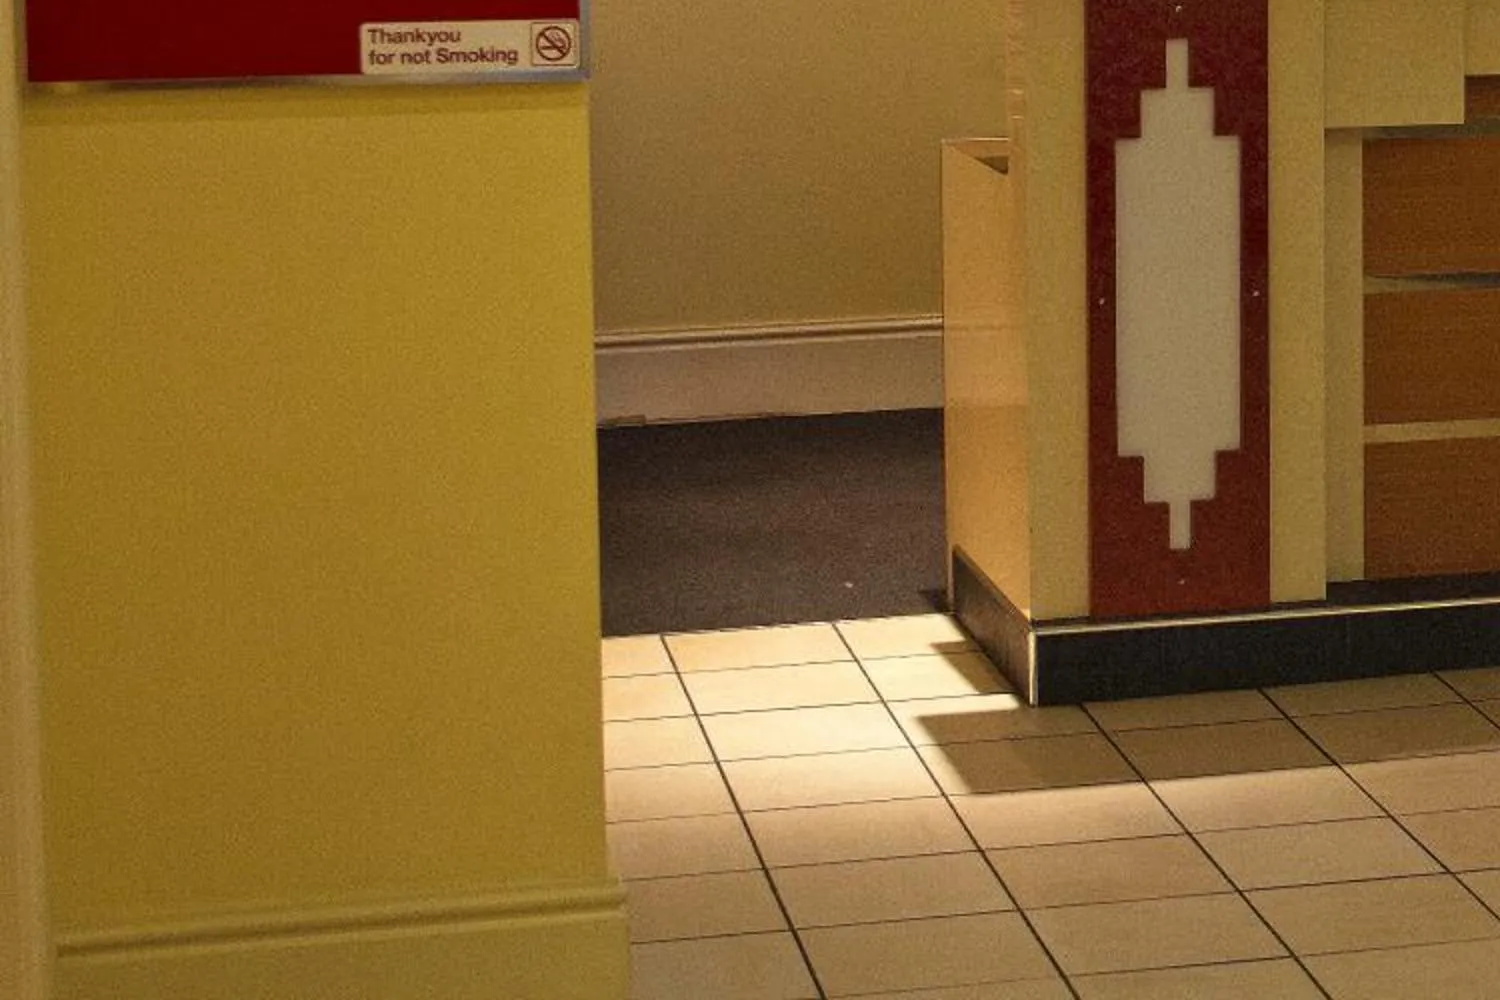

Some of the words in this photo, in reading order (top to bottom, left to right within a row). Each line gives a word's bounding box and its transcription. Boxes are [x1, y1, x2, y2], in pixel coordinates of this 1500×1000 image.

[367, 28, 462, 46] Thankyou
[368, 50, 396, 65] for
[401, 49, 431, 65] not
[436, 46, 519, 66] Smoking
